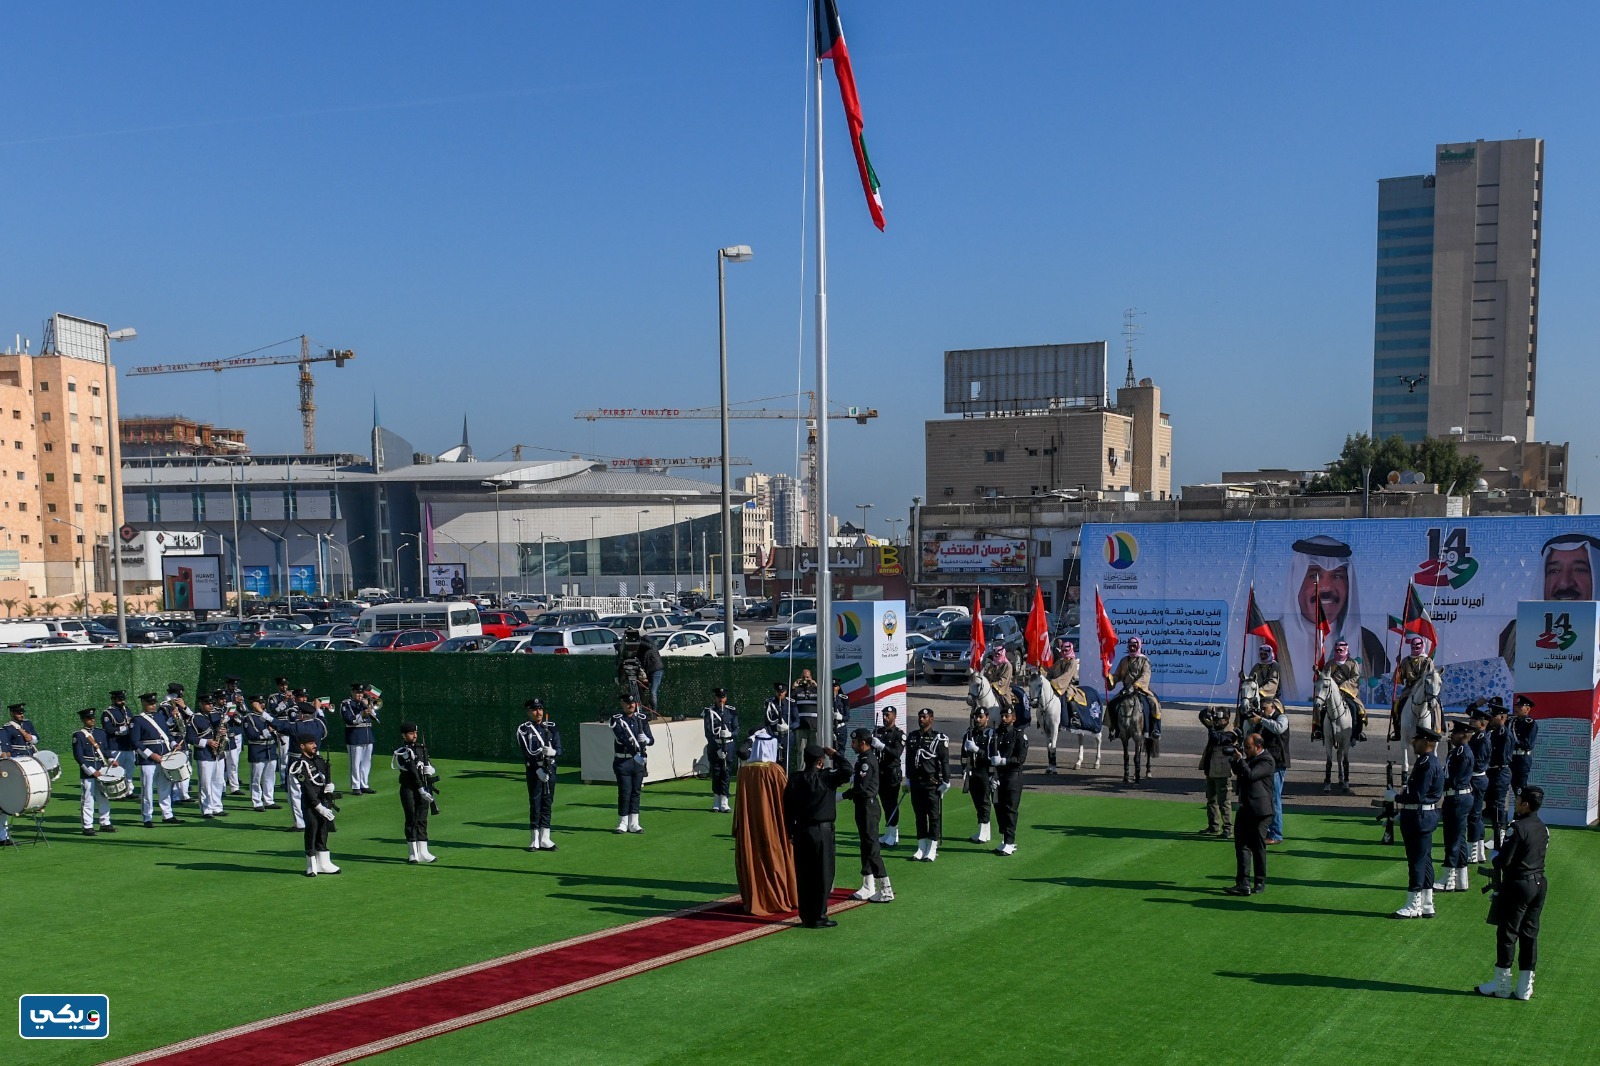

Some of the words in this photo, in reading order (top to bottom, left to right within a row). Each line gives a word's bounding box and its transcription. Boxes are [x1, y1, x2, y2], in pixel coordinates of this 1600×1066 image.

[940, 543, 979, 558] المنتخب
[981, 543, 1011, 558] فرسان
[1433, 596, 1459, 606] سندنا
[1461, 593, 1484, 609] أميرنا
[1138, 608, 1164, 617] ويقين
[1184, 609, 1205, 617] لعلى
[1205, 609, 1221, 619] إنني
[1110, 618, 1145, 626] ستكونون
[1145, 617, 1164, 626] أنكم
[1193, 618, 1221, 627] سبحانه
[1138, 627, 1150, 638] في
[1150, 628, 1185, 637] متعاونين
[1193, 639, 1221, 648] والضراء
[1146, 648, 1181, 656] والنهوض
[1182, 648, 1208, 657] التقدم
[1208, 650, 1221, 658] من
[1568, 652, 1584, 663] أميرنا
[1529, 661, 1544, 670] قوتنا
[1545, 661, 1563, 670] ترابطنا
